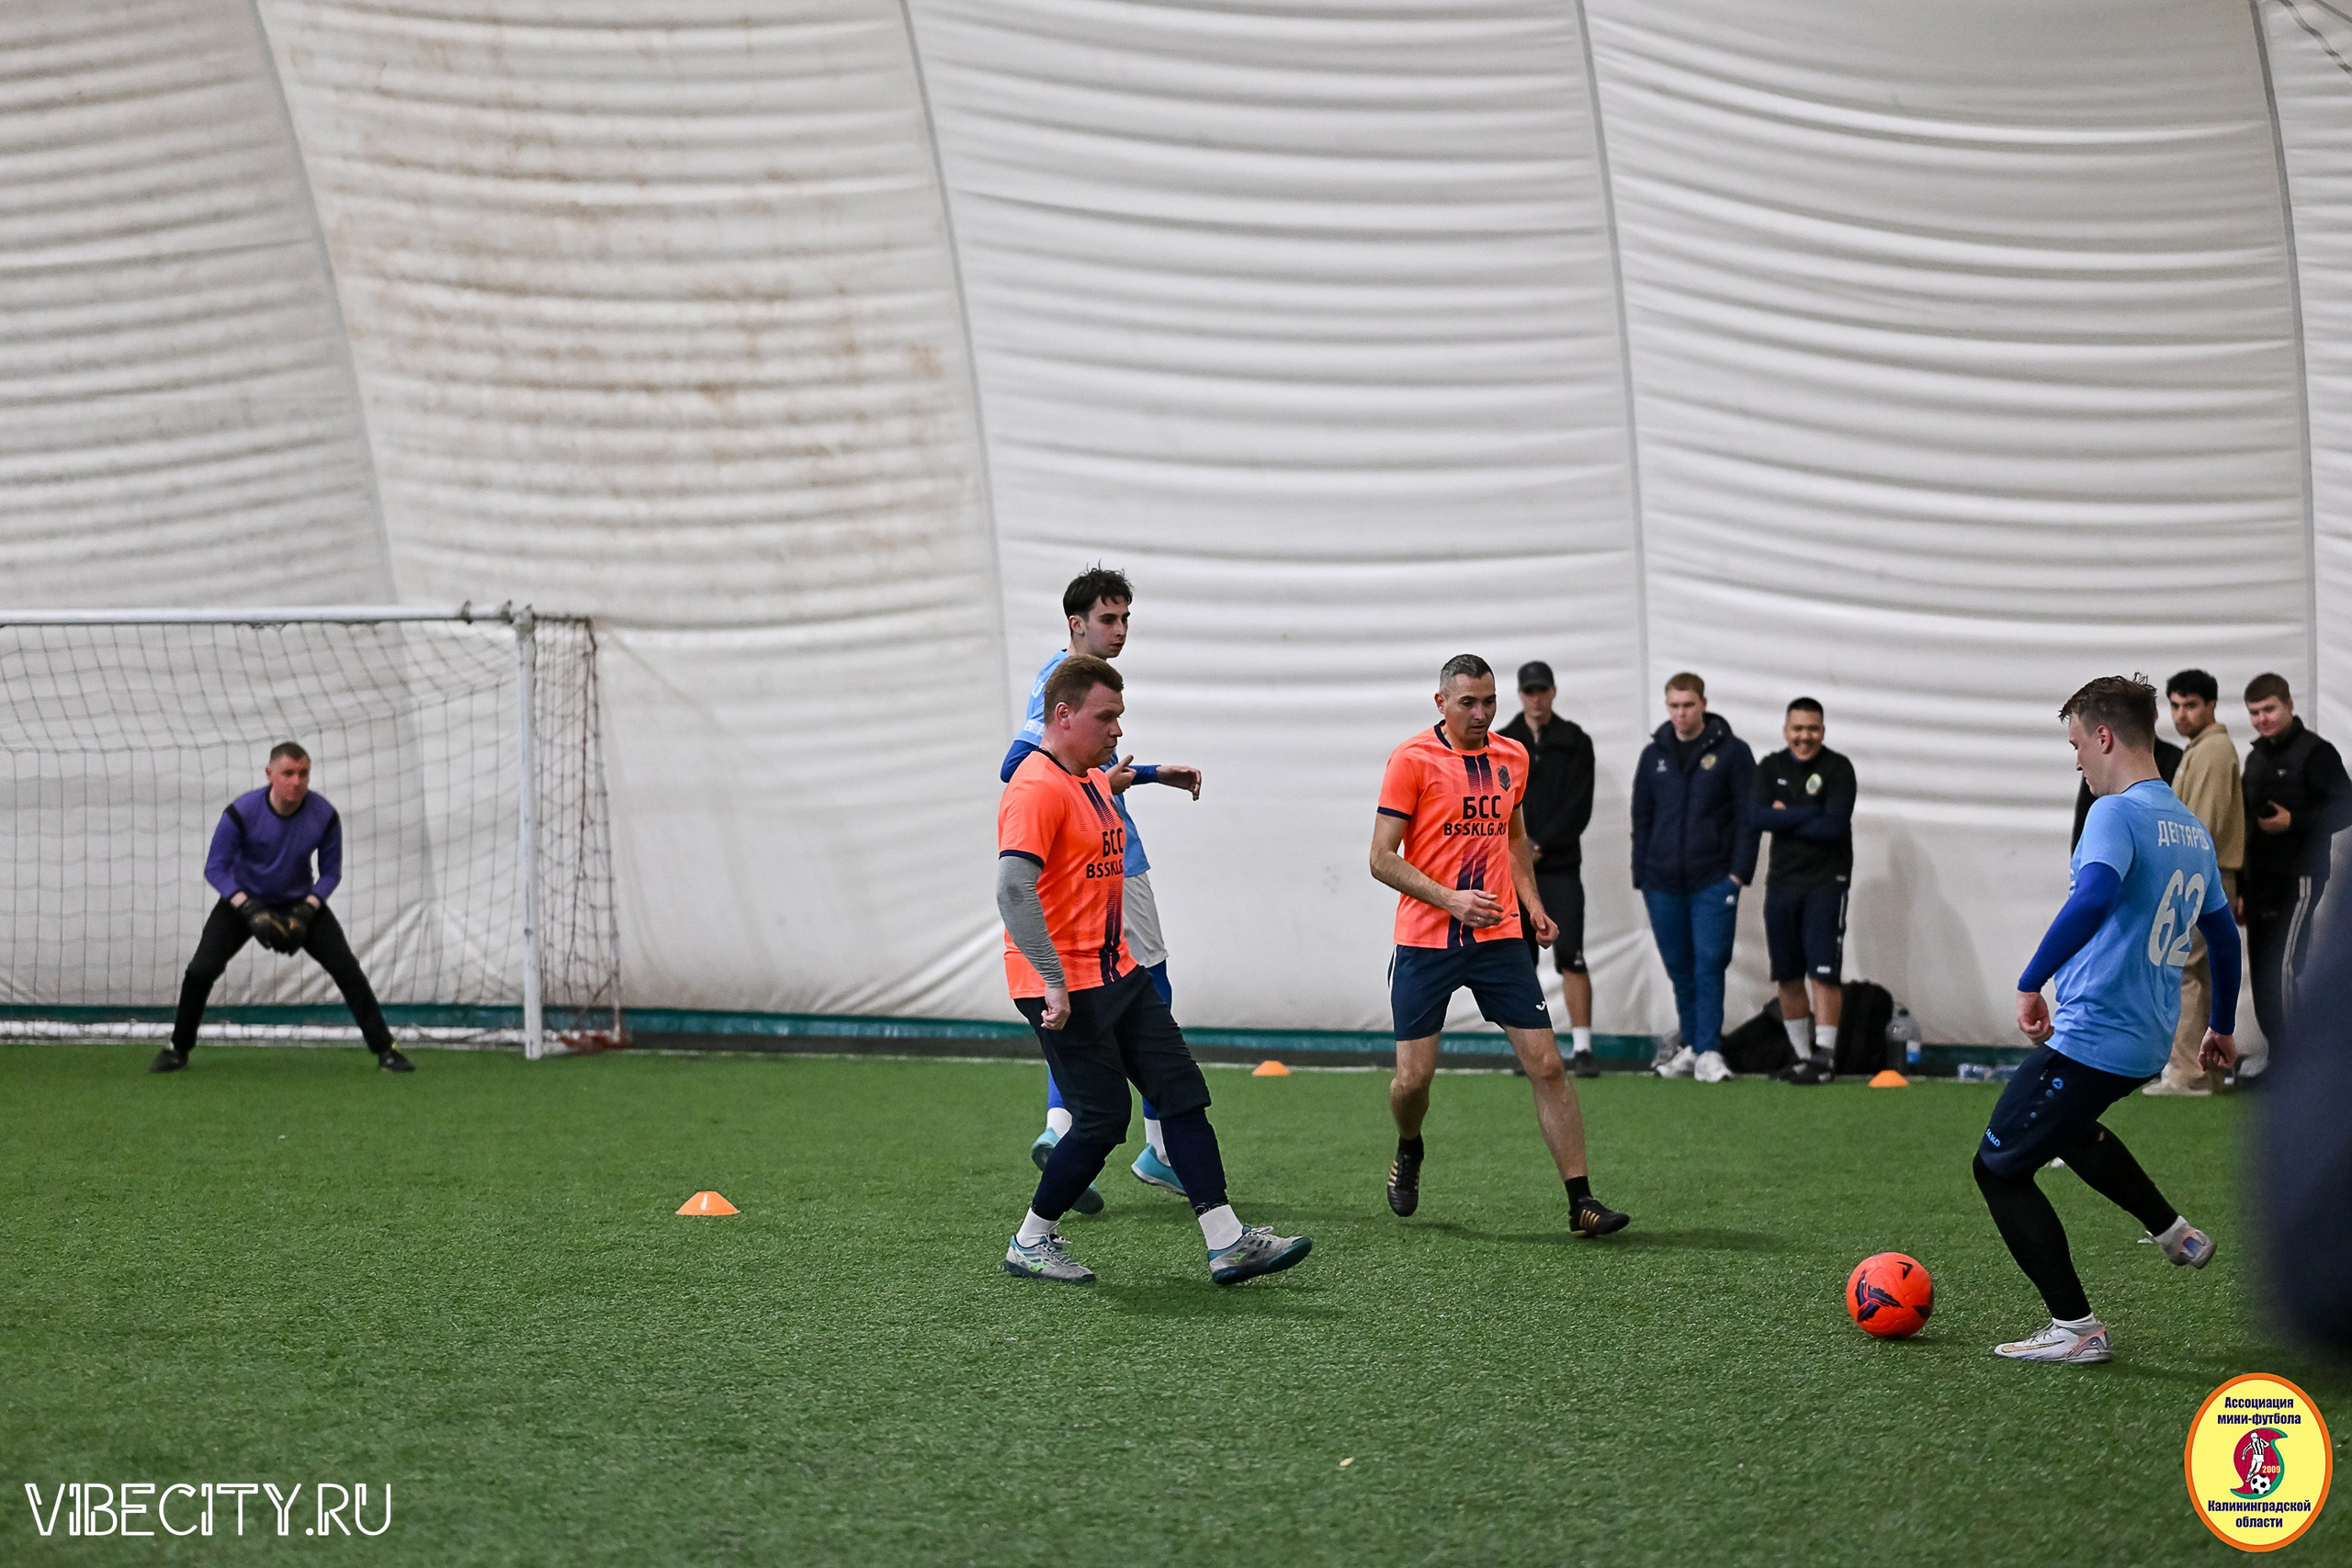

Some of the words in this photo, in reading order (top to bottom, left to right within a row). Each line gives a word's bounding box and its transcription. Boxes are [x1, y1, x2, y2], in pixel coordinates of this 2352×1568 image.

[1462, 795, 1501, 819] БСС
[1102, 827, 1124, 858] БСС
[2148, 869, 2205, 967] 62
